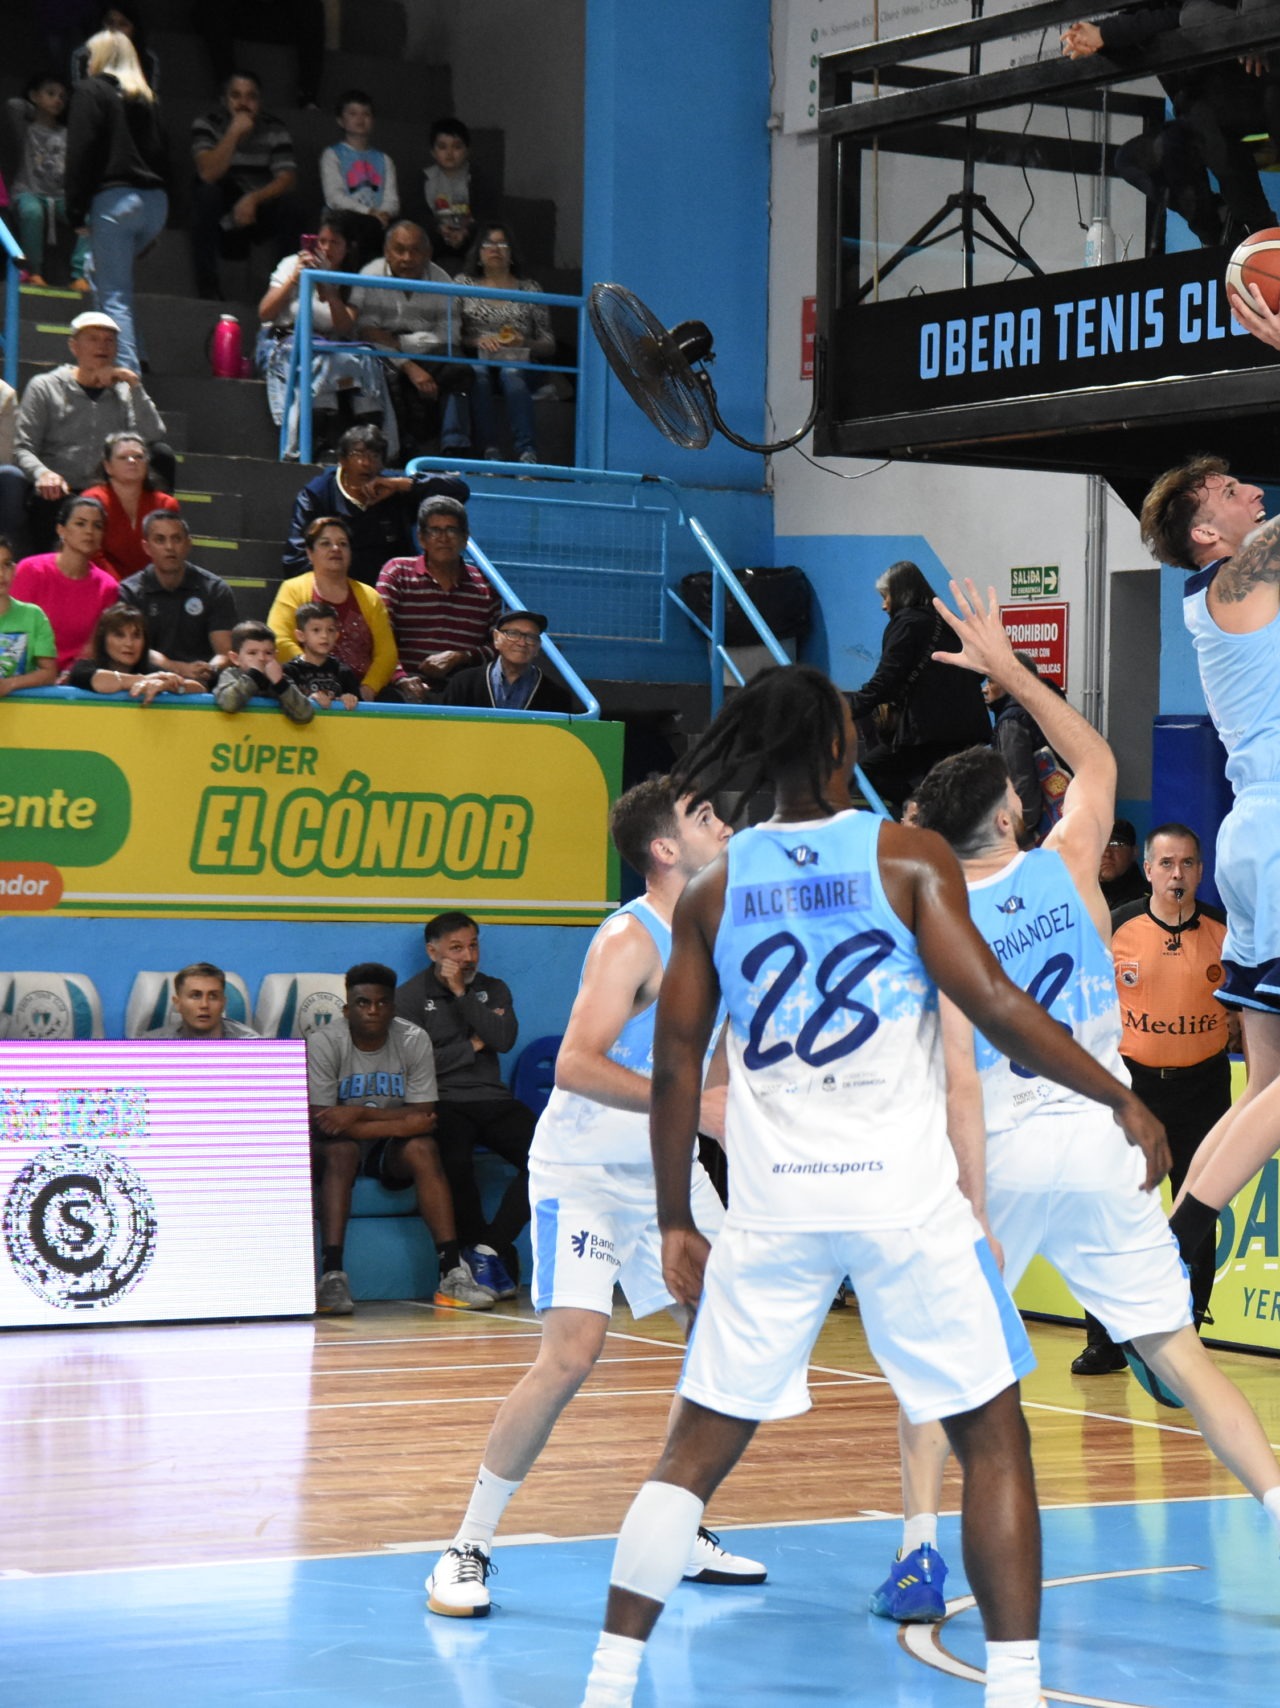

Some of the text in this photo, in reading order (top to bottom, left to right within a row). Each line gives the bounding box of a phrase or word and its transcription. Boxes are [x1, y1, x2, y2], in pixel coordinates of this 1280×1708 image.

[919, 278, 1251, 380] OBERA TENIS CL
[1012, 570, 1041, 585] SALIDA
[209, 734, 319, 776] SÚPER
[191, 770, 534, 880] EL CÓNDOR
[743, 879, 860, 920] ALCEGAIRE
[989, 902, 1076, 966] RNANDEZ
[740, 929, 898, 1072] 28
[1125, 1009, 1219, 1036] Medifé
[771, 1160, 884, 1176] atlanticsports
